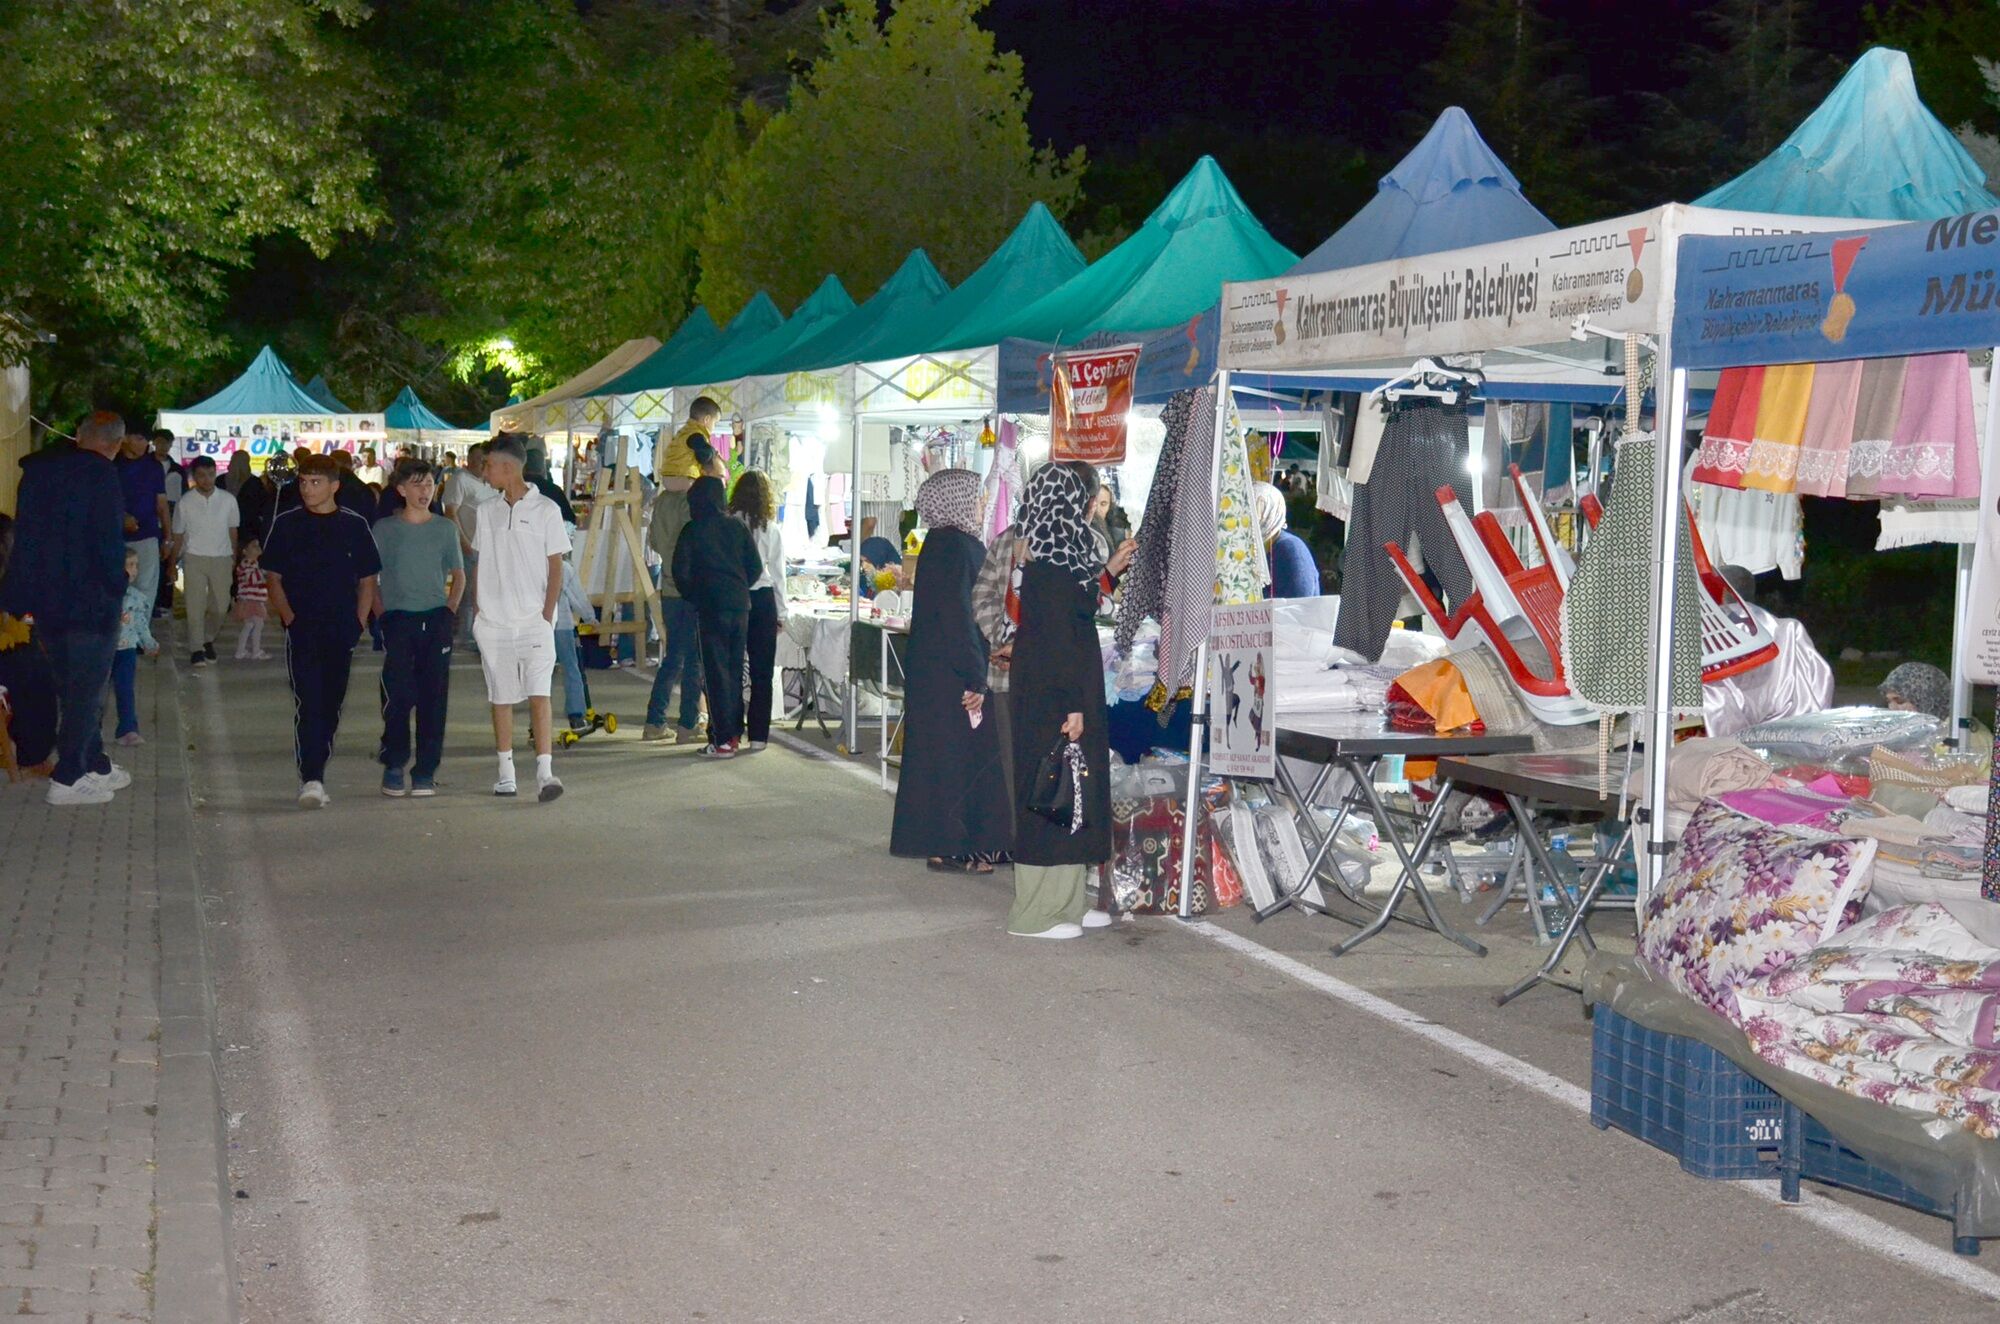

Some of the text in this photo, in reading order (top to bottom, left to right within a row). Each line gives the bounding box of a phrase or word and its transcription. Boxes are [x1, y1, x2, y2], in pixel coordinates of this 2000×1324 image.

[1551, 267, 1625, 293] Kahramanmaraş
[1703, 280, 1820, 311] Kahramanmaraş
[1918, 267, 2000, 317] Mü
[1296, 257, 1540, 341] Kahramanmaraş Büyükşehir Belediyesi
[1549, 290, 1625, 322] Büyükşehir Belediyesi
[1700, 307, 1822, 344] Büyükşehir Belediyesi
[1236, 610, 1246, 626] 23
